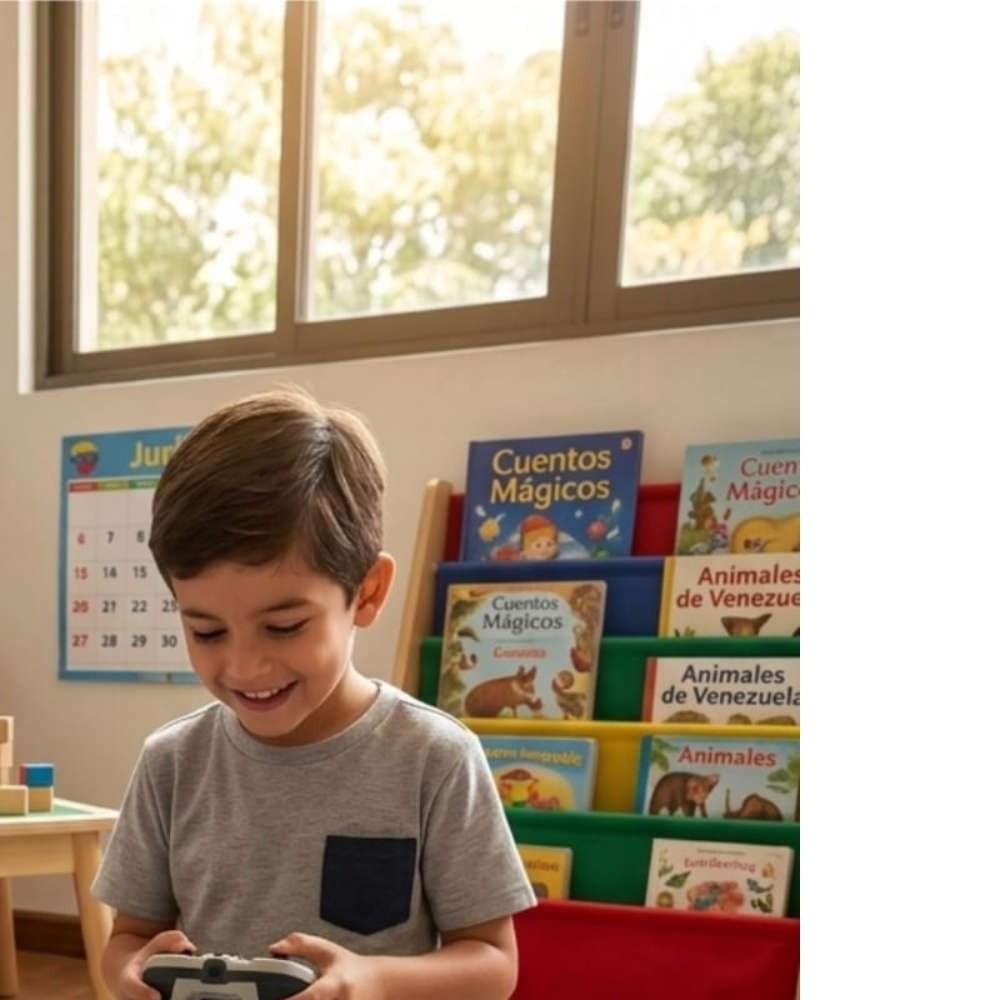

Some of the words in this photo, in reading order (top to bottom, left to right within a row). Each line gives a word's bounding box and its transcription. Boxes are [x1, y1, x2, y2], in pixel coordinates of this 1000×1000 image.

[492, 448, 612, 475] Cuentos
[740, 456, 800, 478] Cuen
[490, 476, 611, 510] Mágicos
[131, 600, 147, 613] 22
[491, 595, 560, 611] Cuentos
[676, 588, 703, 608] de
[482, 613, 563, 635] Mágicos
[72, 634, 89, 648] 27
[102, 634, 118, 648] 28
[131, 634, 148, 648] 29
[161, 634, 178, 648] 30
[681, 664, 786, 684] Animales
[661, 685, 687, 705] de
[677, 745, 777, 768] Animales
